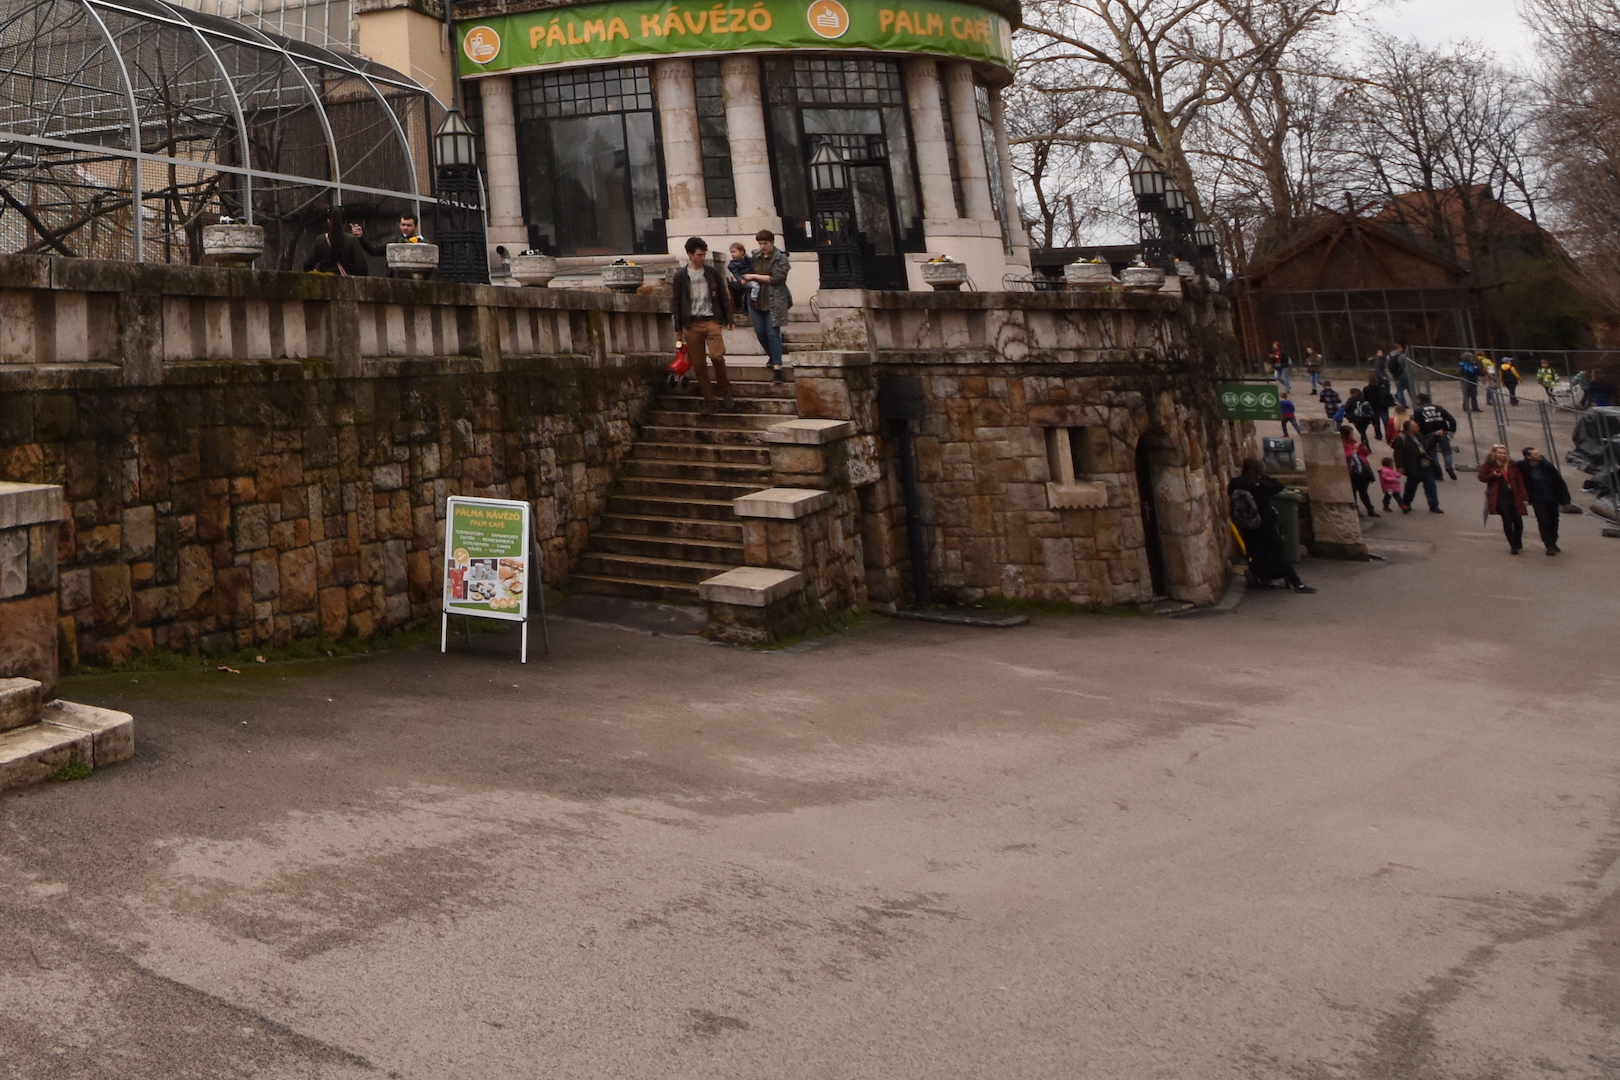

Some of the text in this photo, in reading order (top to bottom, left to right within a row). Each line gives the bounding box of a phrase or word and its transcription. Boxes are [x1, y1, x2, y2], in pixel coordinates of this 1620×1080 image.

[530, 1, 773, 50] PÁLMA KÁVÉZÓ
[879, 9, 992, 46] PALM CAFÉ
[455, 507, 521, 521] PÁLMA KÁVÉZÓ
